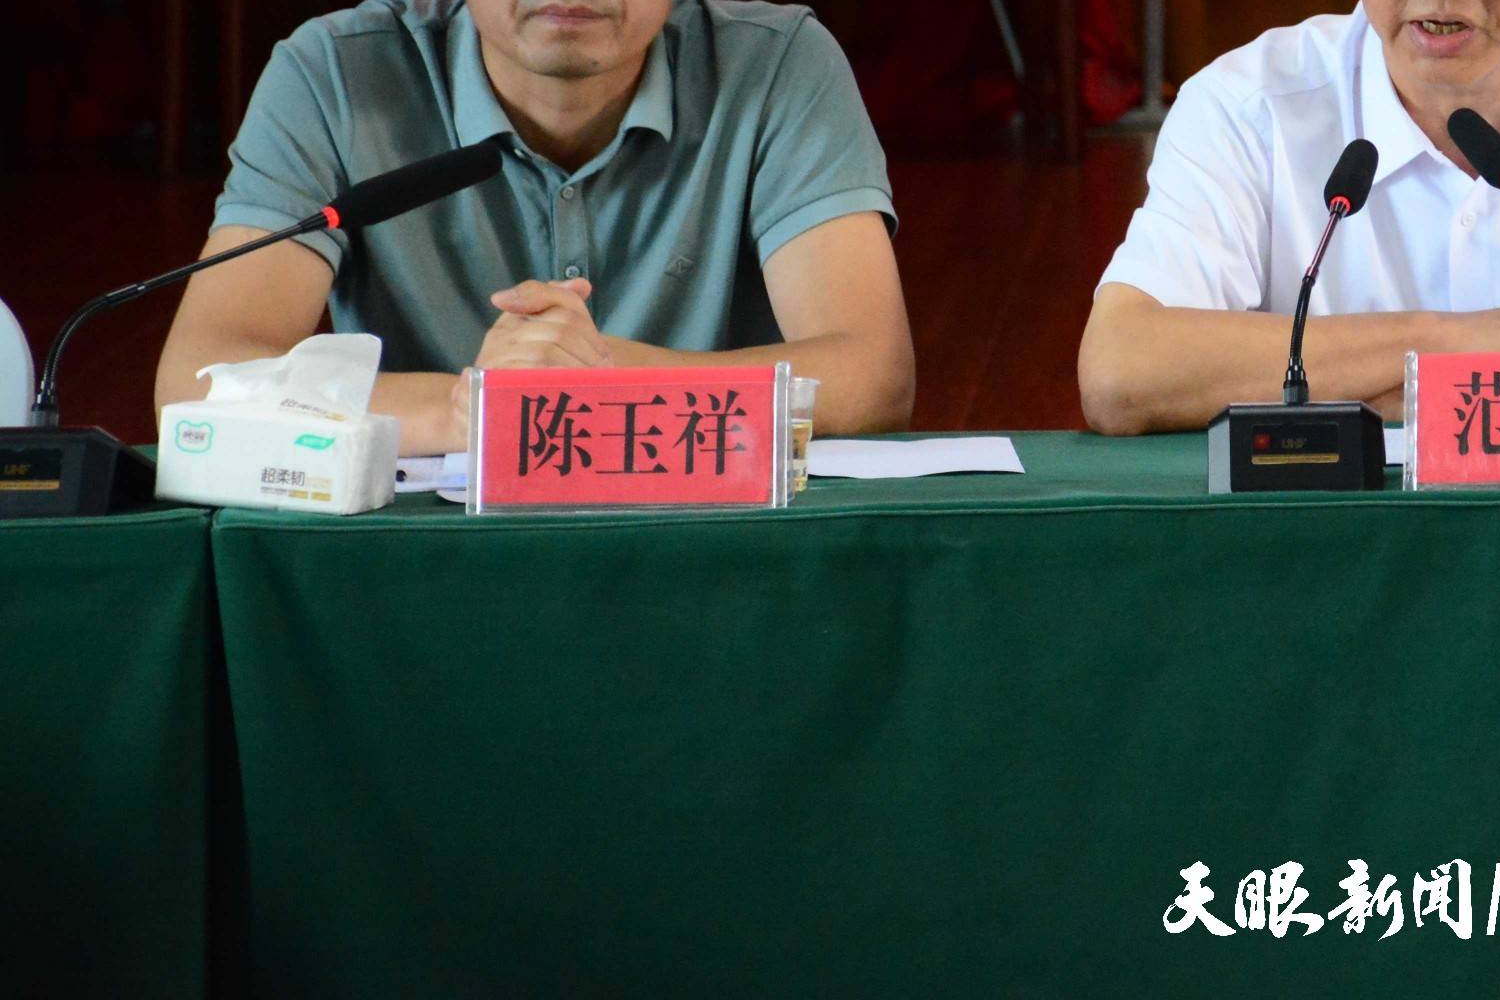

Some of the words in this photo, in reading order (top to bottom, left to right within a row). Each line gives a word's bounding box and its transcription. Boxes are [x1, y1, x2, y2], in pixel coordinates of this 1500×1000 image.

[517, 390, 748, 477] 陈玉祥
[260, 467, 306, 487] 超柔韧
